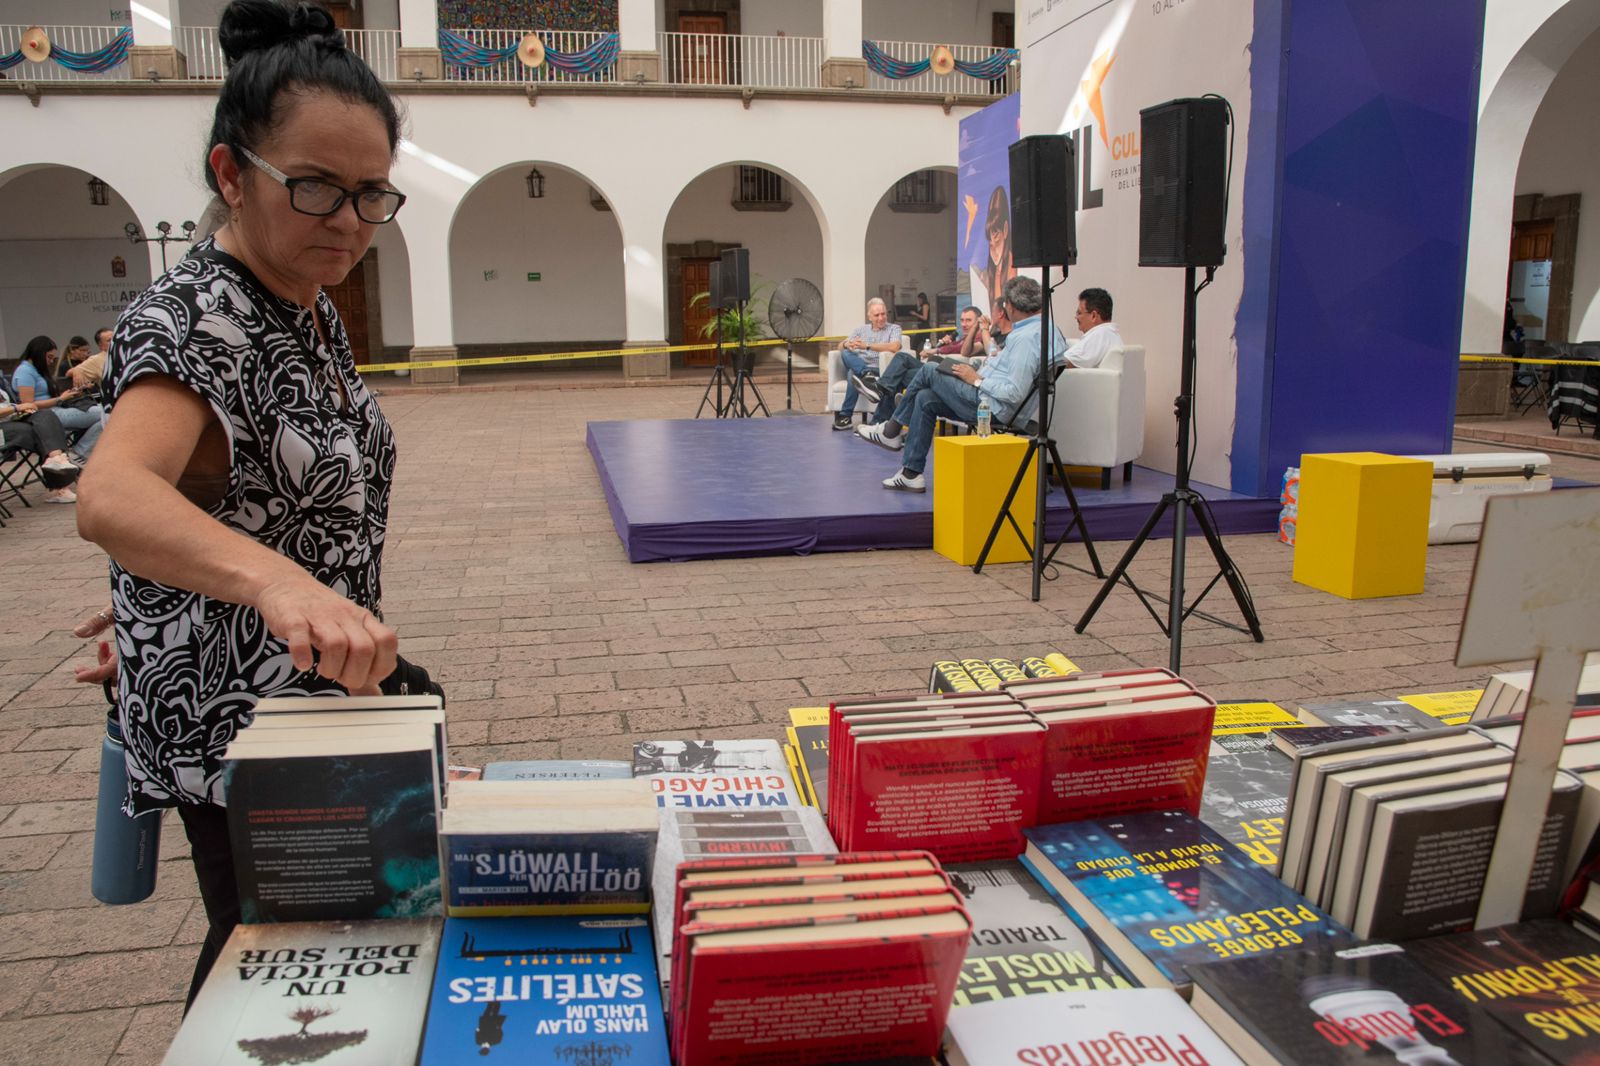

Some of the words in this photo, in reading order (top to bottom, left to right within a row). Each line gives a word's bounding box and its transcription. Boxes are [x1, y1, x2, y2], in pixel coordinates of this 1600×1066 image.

[1111, 168, 1128, 178] FERIA
[1118, 180, 1129, 190] DEL
[65, 291, 118, 304] CABILDO
[653, 776, 785, 793] CHICAGO
[707, 841, 788, 853] INVIERNO
[1155, 850, 1169, 860] A
[1171, 843, 1224, 856] VOLVIÓ
[454, 854, 474, 862] MAJ
[475, 850, 605, 876] SJÖWALL
[1076, 855, 1132, 872] CIUDAD
[1134, 852, 1154, 864] LA
[1137, 857, 1200, 876] HOMBRE
[1201, 855, 1222, 866] EL
[509, 874, 527, 882] PER
[528, 868, 641, 893] WAHLÖÖ
[1103, 868, 1135, 880] QUE
[1150, 904, 1320, 947] PELECANOS
[971, 925, 1067, 946] TRAICI
[1208, 929, 1303, 958] GEORGE
[240, 948, 326, 964] SUR
[338, 944, 421, 961] DEL
[237, 960, 413, 985] POLICÍA
[1451, 954, 1600, 1002] ALIFORNIA
[282, 980, 347, 997] UN
[448, 974, 644, 1005] SATÉLITES
[566, 1004, 647, 1019] LAHLUM
[1408, 1003, 1464, 1036] El
[535, 1019, 588, 1035] OLAV
[594, 1018, 649, 1033] HANS
[1313, 1010, 1418, 1050] duelo
[1525, 1003, 1600, 1040] NAS
[1017, 1031, 1212, 1066] Plegarias
